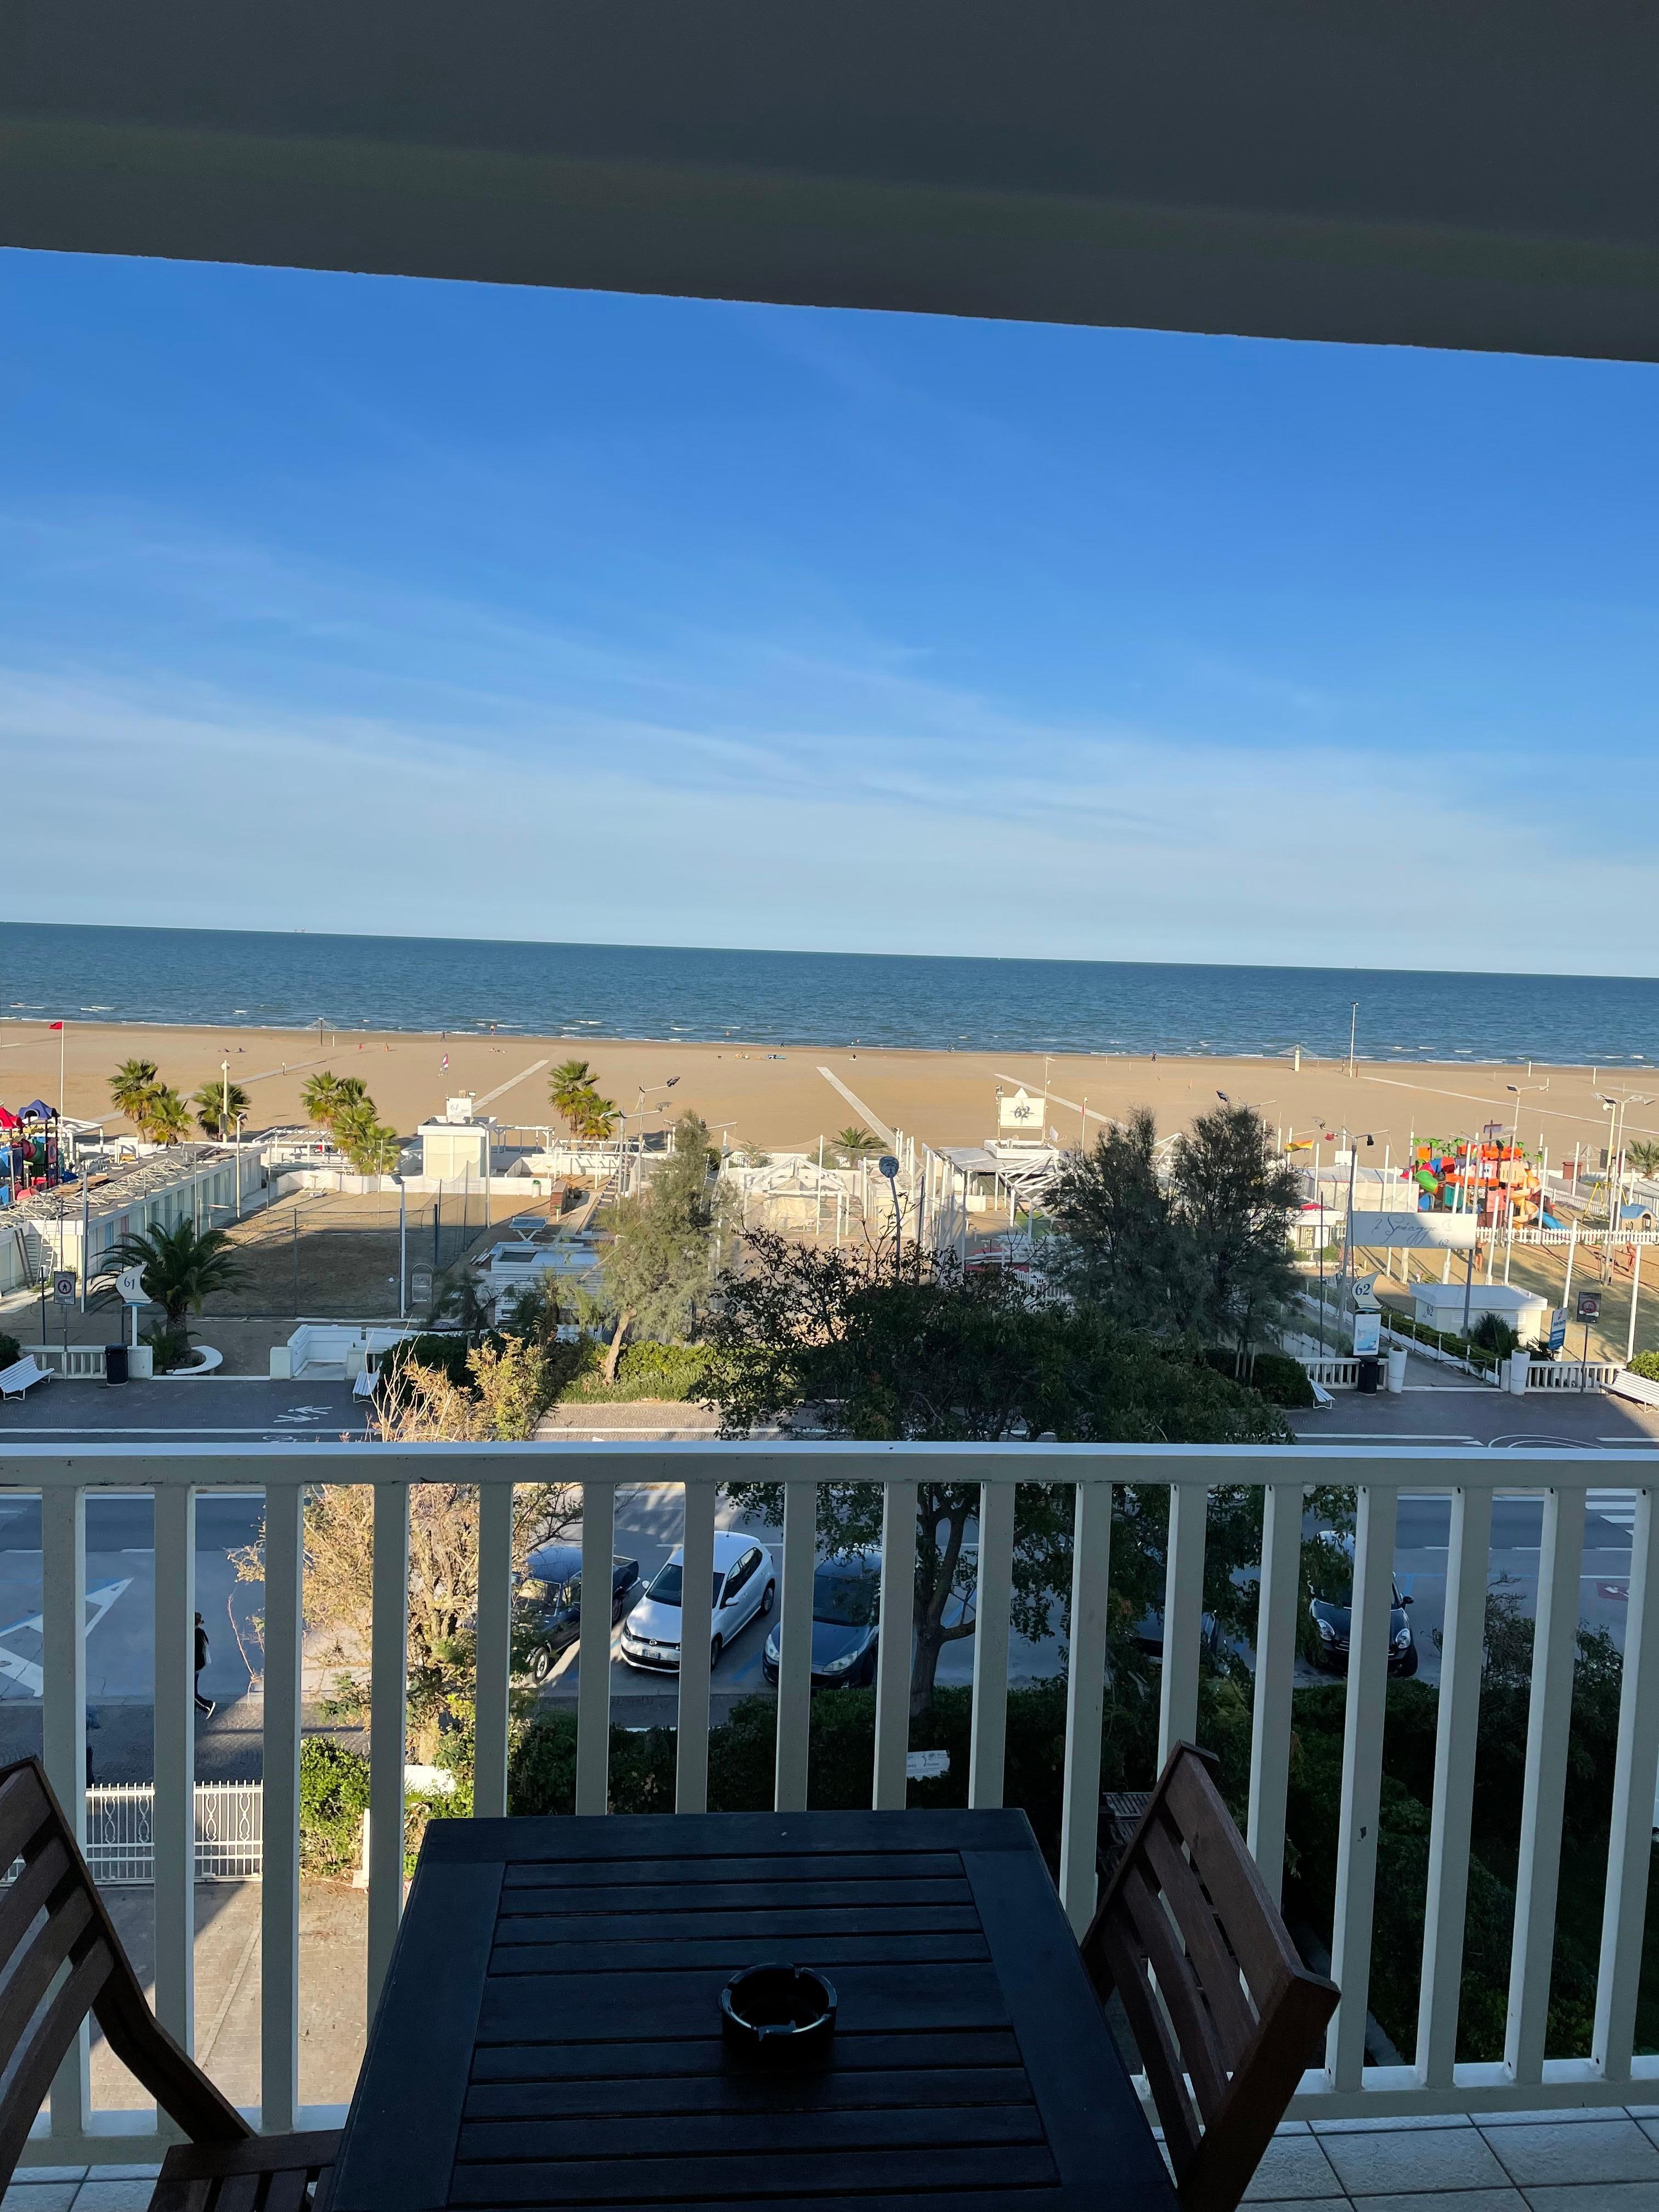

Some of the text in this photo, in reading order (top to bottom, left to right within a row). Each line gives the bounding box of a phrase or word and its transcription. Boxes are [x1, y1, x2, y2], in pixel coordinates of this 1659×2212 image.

[1014, 1106, 1030, 1118] 62
[1438, 1238, 1449, 1247] 62
[124, 1276, 135, 1290] 61
[1355, 1283, 1371, 1296] 62
